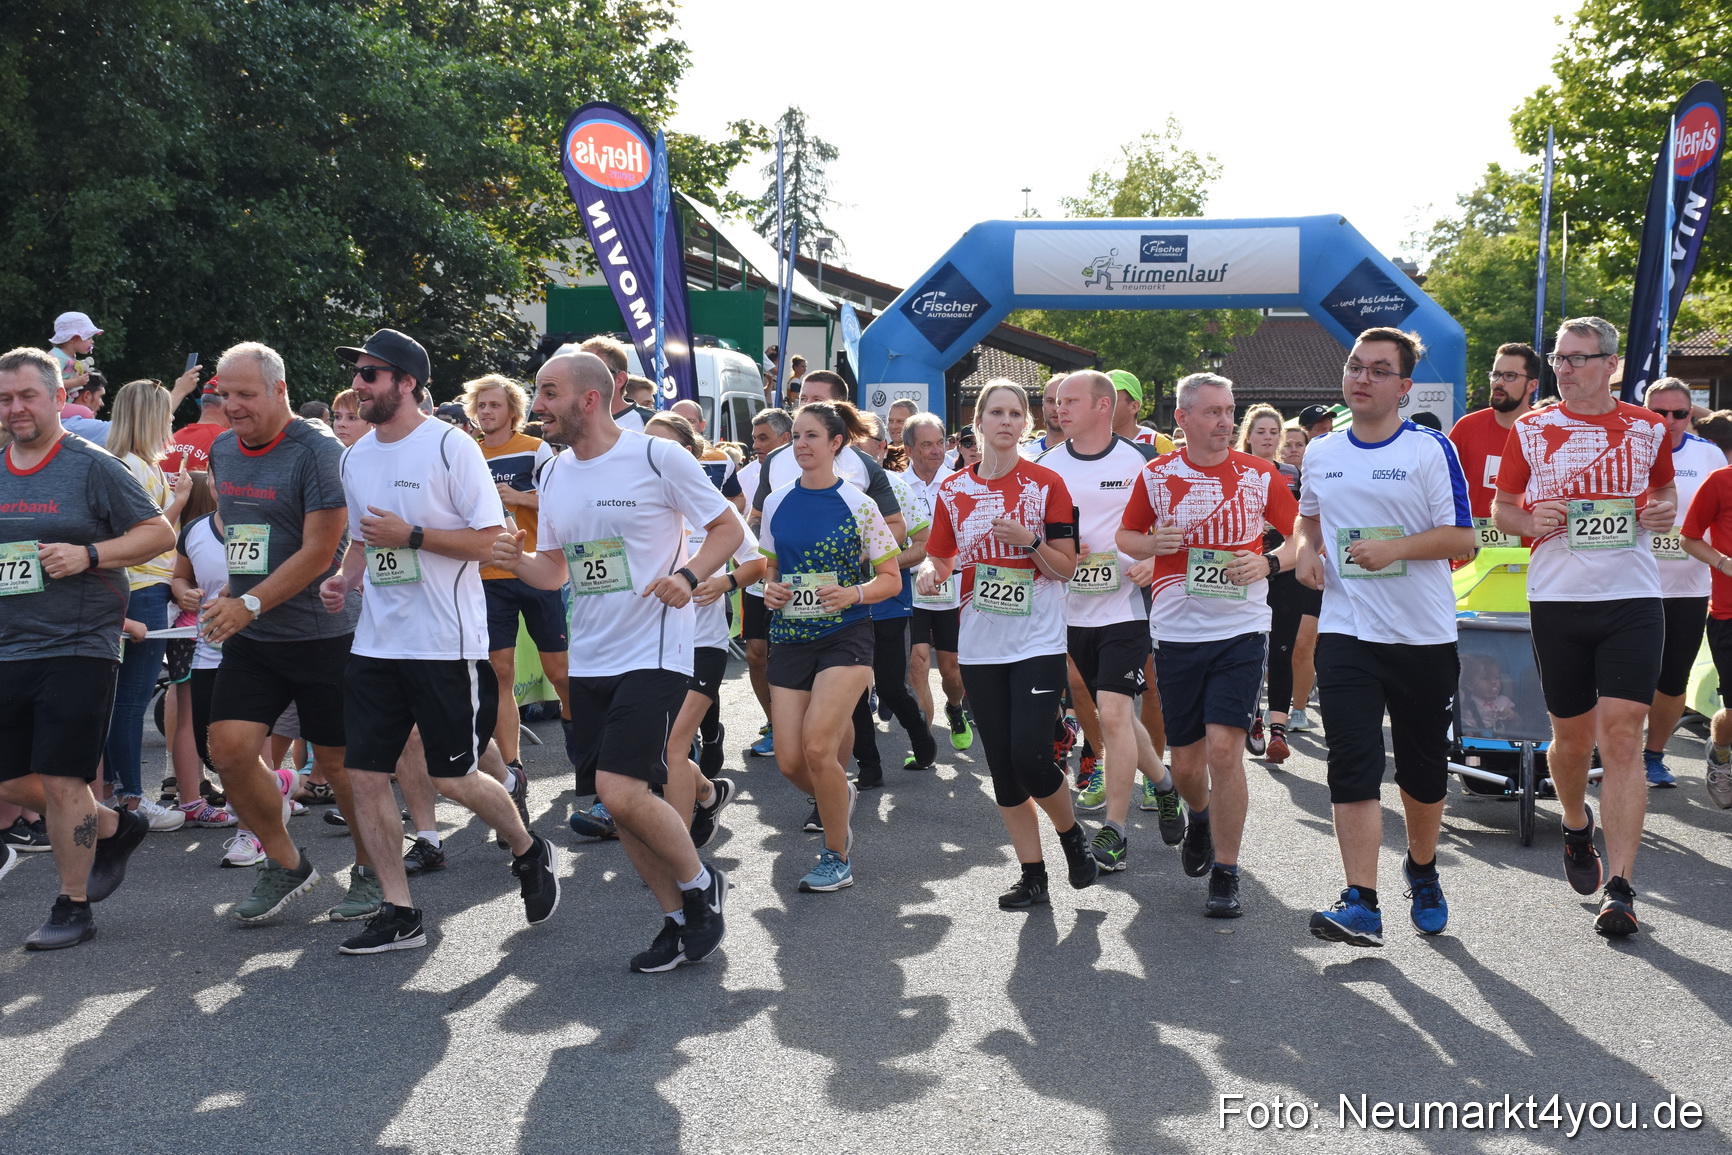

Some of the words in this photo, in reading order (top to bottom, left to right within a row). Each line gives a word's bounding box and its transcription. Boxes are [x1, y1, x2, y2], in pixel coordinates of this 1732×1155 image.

[1674, 121, 1716, 160] Hervis
[1150, 245, 1186, 253] Fischer
[1122, 263, 1229, 282] firmenlauf
[922, 300, 978, 312] Fischer
[194, 449, 208, 461] SV
[1325, 471, 1343, 479] JAKO
[220, 481, 278, 500] Oberbank
[0, 500, 60, 514] erbank
[597, 499, 637, 508] auctores
[1576, 516, 1628, 536] 2202
[1653, 536, 1680, 550] 933
[376, 551, 397, 571] 26
[583, 559, 607, 580] 25
[1194, 566, 1236, 585] 220
[979, 581, 1025, 603] 2226
